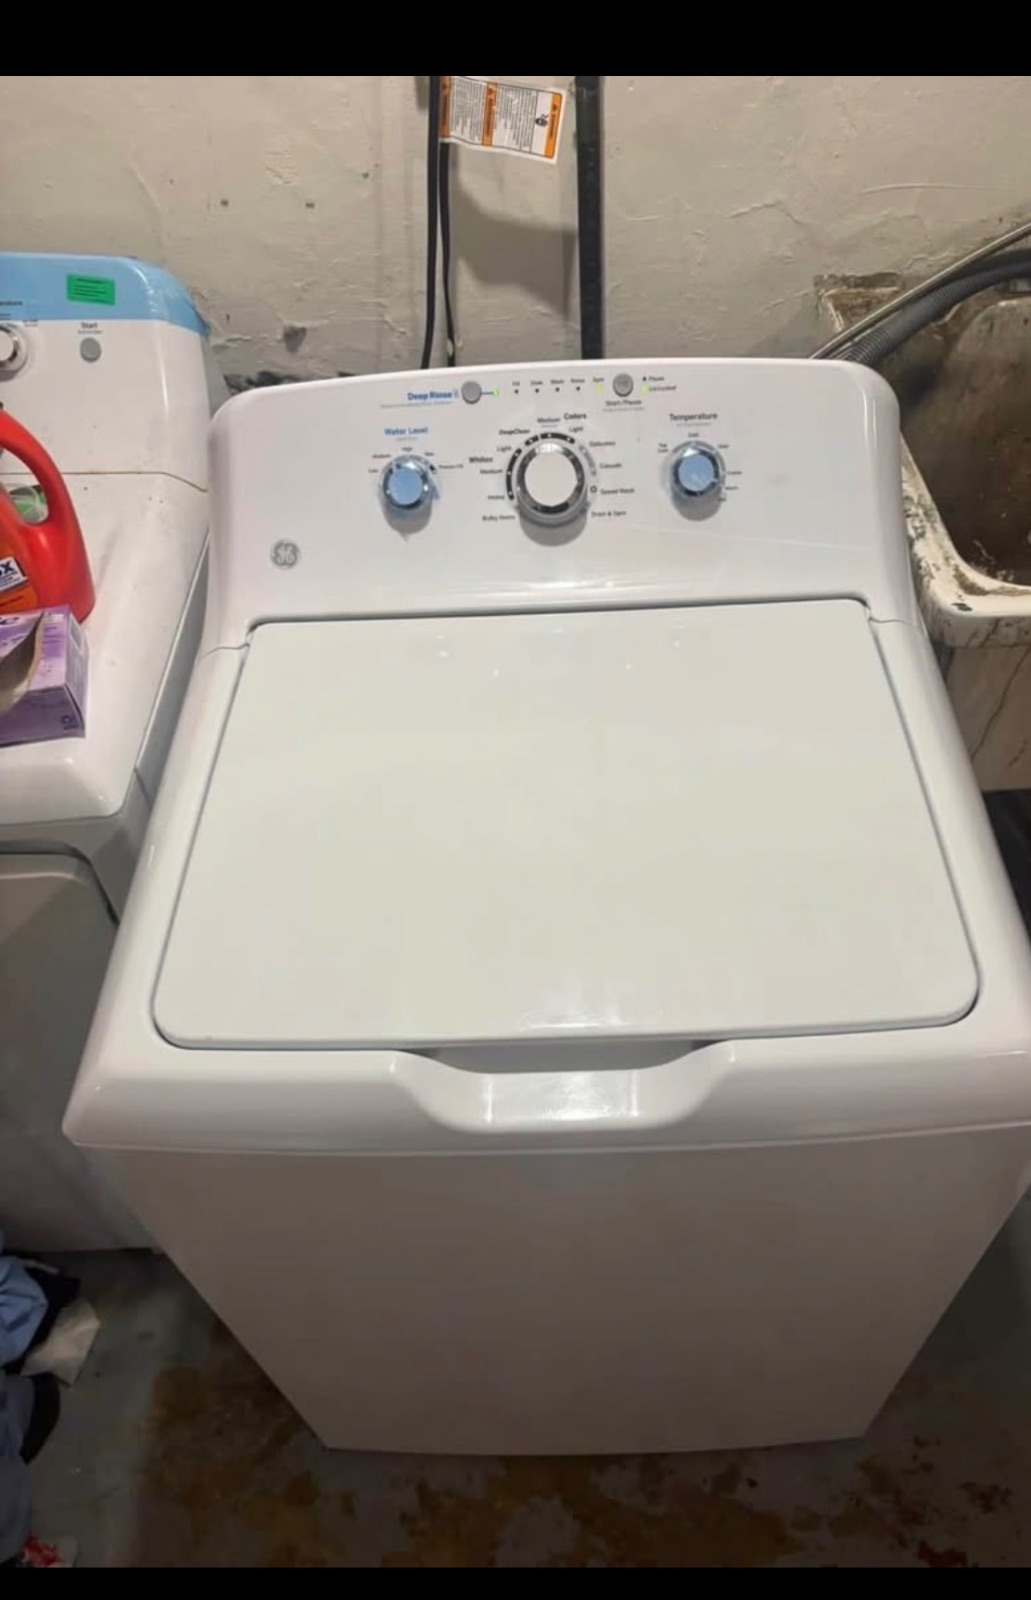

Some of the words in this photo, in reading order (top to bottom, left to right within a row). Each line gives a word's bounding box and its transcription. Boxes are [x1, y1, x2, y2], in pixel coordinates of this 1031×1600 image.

[407, 392, 429, 401] Deep
[429, 391, 452, 399] Rinse
[564, 412, 587, 420] Colors
[669, 413, 718, 421] Temperature
[384, 427, 406, 435] Water
